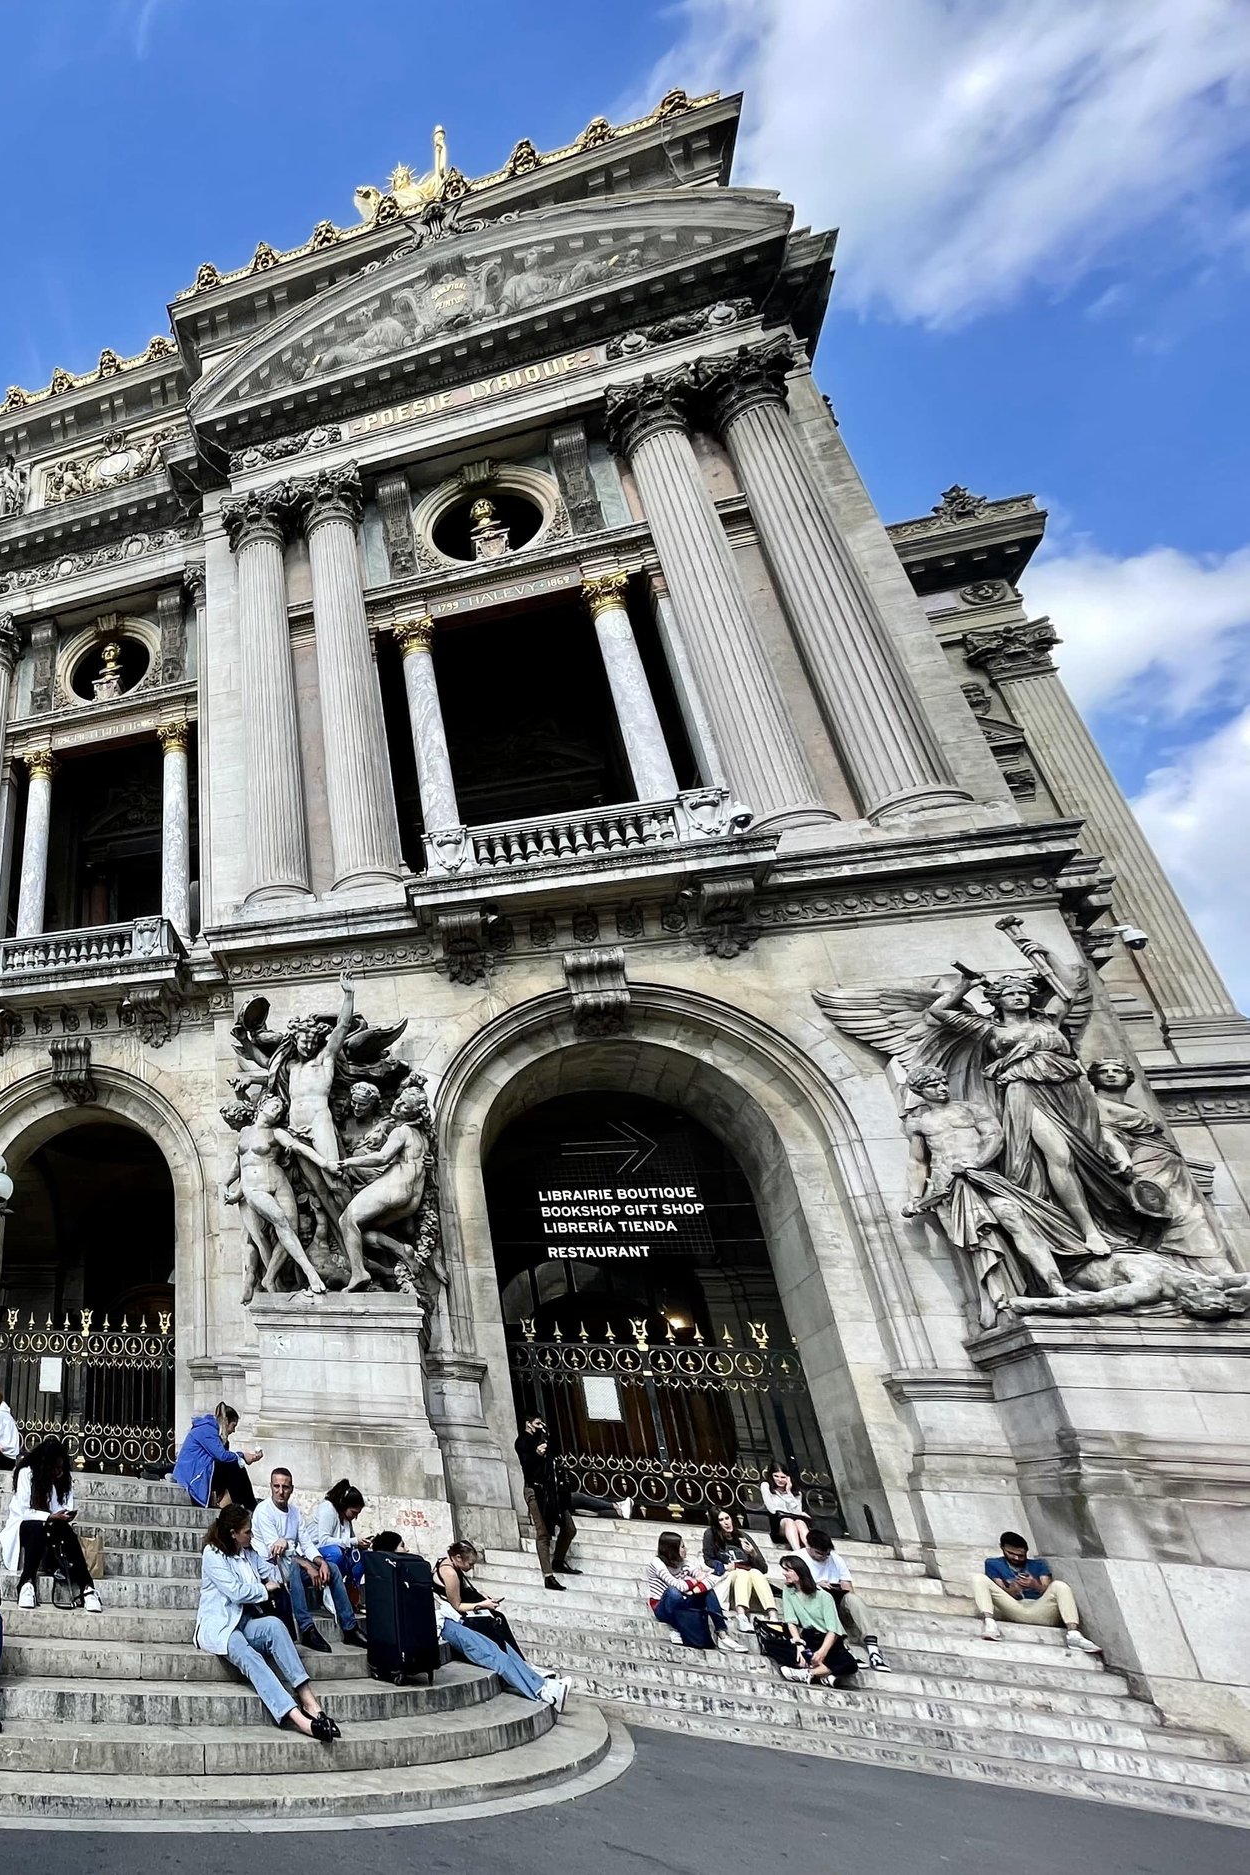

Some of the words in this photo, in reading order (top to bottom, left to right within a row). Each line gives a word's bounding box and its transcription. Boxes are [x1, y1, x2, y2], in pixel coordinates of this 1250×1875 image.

[363, 391, 454, 432] POESIE
[468, 353, 579, 400] LYRIQUE
[468, 582, 537, 606] HALEVY
[538, 1188, 613, 1202] LIBRAIRIE
[616, 1186, 697, 1200] BOUTIQUE
[541, 1205, 621, 1217] BOOKSHOP
[624, 1204, 658, 1216] GIFT
[661, 1203, 705, 1215] SHOP
[543, 1219, 615, 1233] LIBRERÍA
[618, 1220, 678, 1232] TIENDA
[547, 1245, 650, 1259] RESTAURANT
